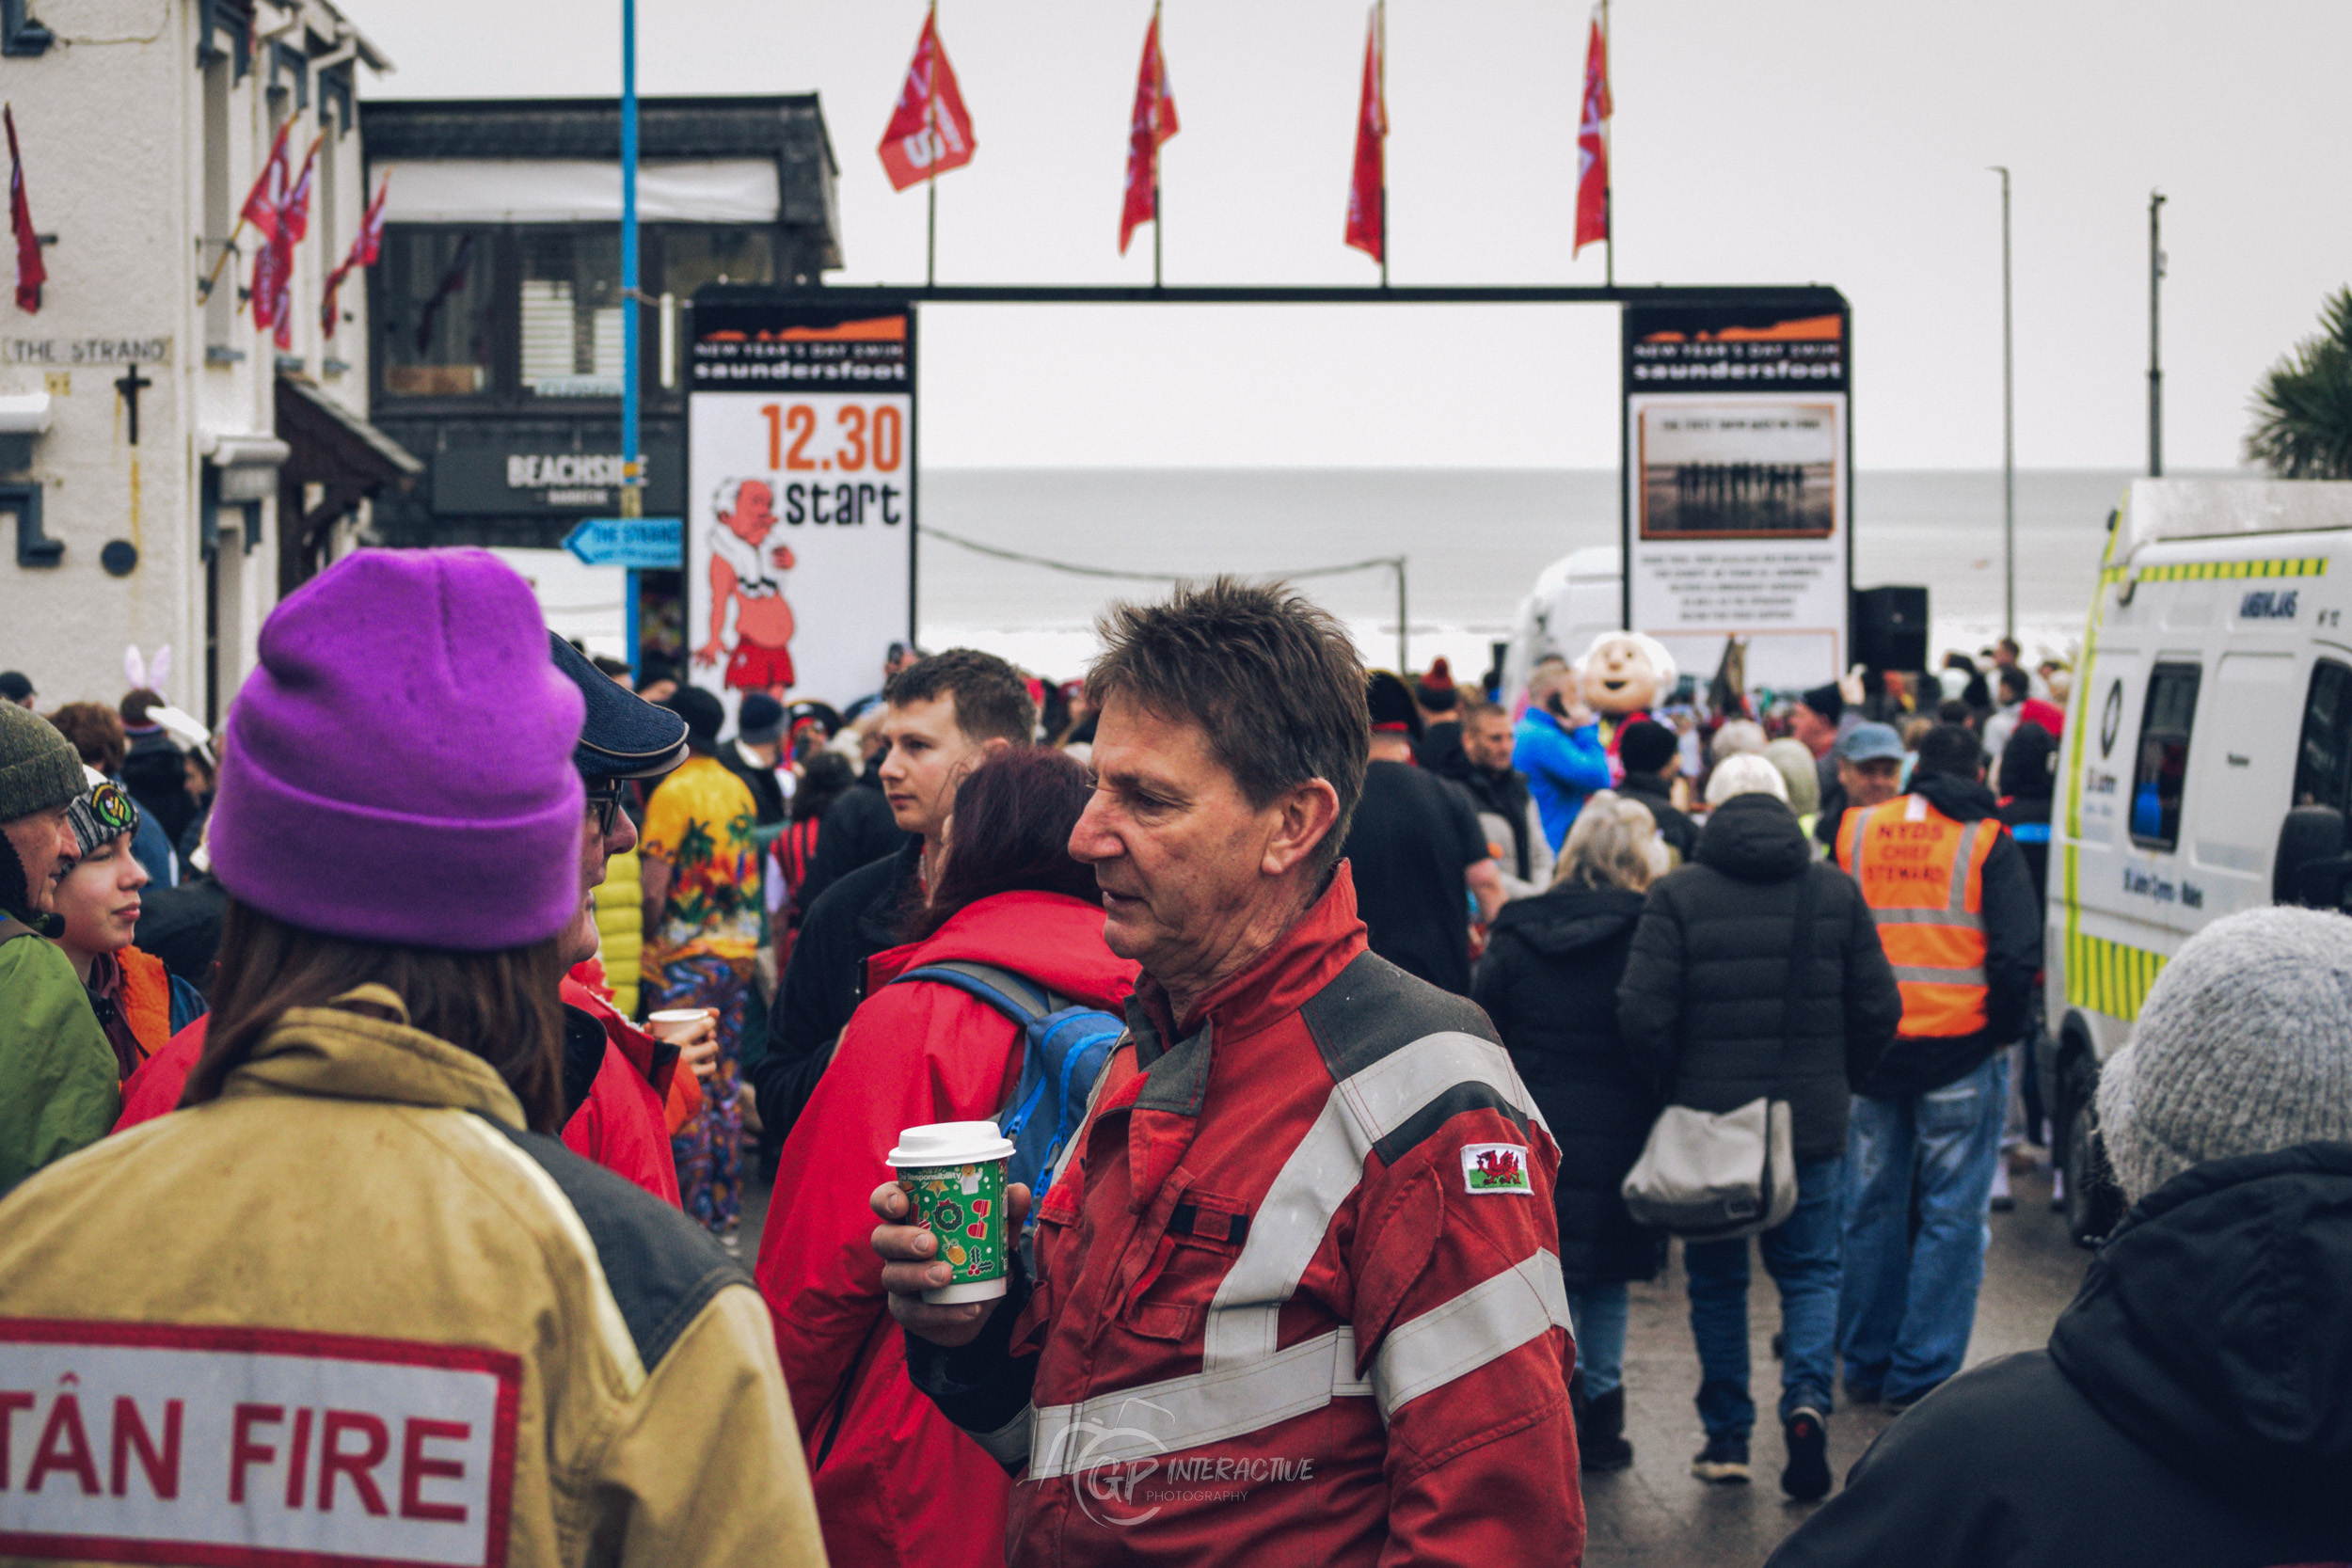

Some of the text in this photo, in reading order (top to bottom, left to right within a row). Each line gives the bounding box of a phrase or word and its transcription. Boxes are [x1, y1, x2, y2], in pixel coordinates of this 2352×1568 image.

[14, 338, 166, 362] THE STRAND
[693, 342, 904, 357] NEW YEAR'S DAY SWIM
[1633, 343, 1677, 358] NEW
[1747, 343, 1784, 358] DAY
[1790, 342, 1840, 357] SWIM
[693, 360, 907, 380] saundersfoot
[1633, 359, 1842, 380] saundersfoot
[761, 404, 902, 472] 12.30
[787, 483, 900, 525] start
[1878, 823, 1945, 841] NYDS
[1881, 845, 1931, 861] CHIEF
[1867, 864, 1946, 883] STEWARD
[907, 1171, 961, 1181] Responsibility
[228, 1402, 472, 1524] FIRE
